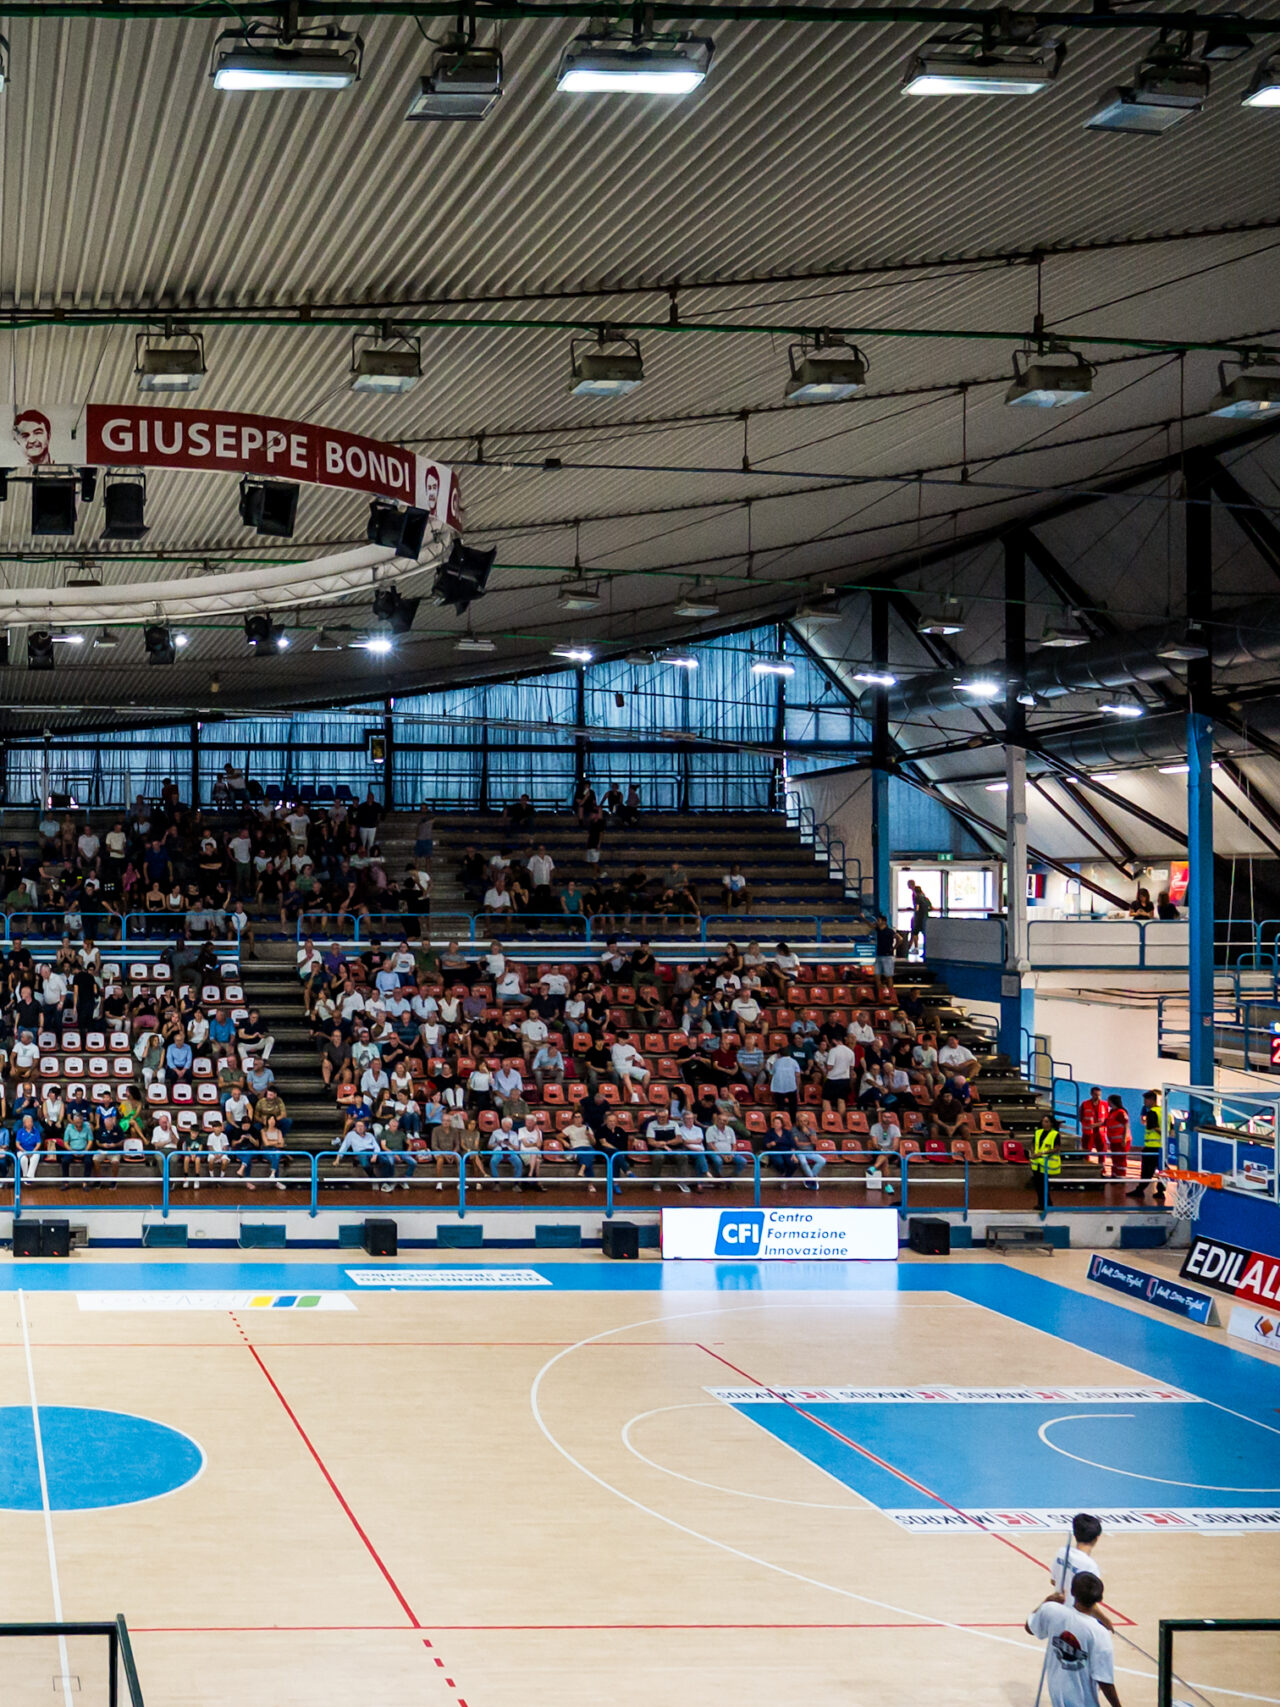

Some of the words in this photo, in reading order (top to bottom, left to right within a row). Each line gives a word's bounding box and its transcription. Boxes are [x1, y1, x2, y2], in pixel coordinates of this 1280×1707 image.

[101, 417, 308, 469] GIUSEPPE
[326, 440, 411, 492] BONDI
[769, 1211, 813, 1222] Centro
[722, 1223, 760, 1244] CFI
[767, 1228, 847, 1239] Formazione
[764, 1245, 848, 1256] Innovazione
[1185, 1241, 1280, 1303] EDILAL
